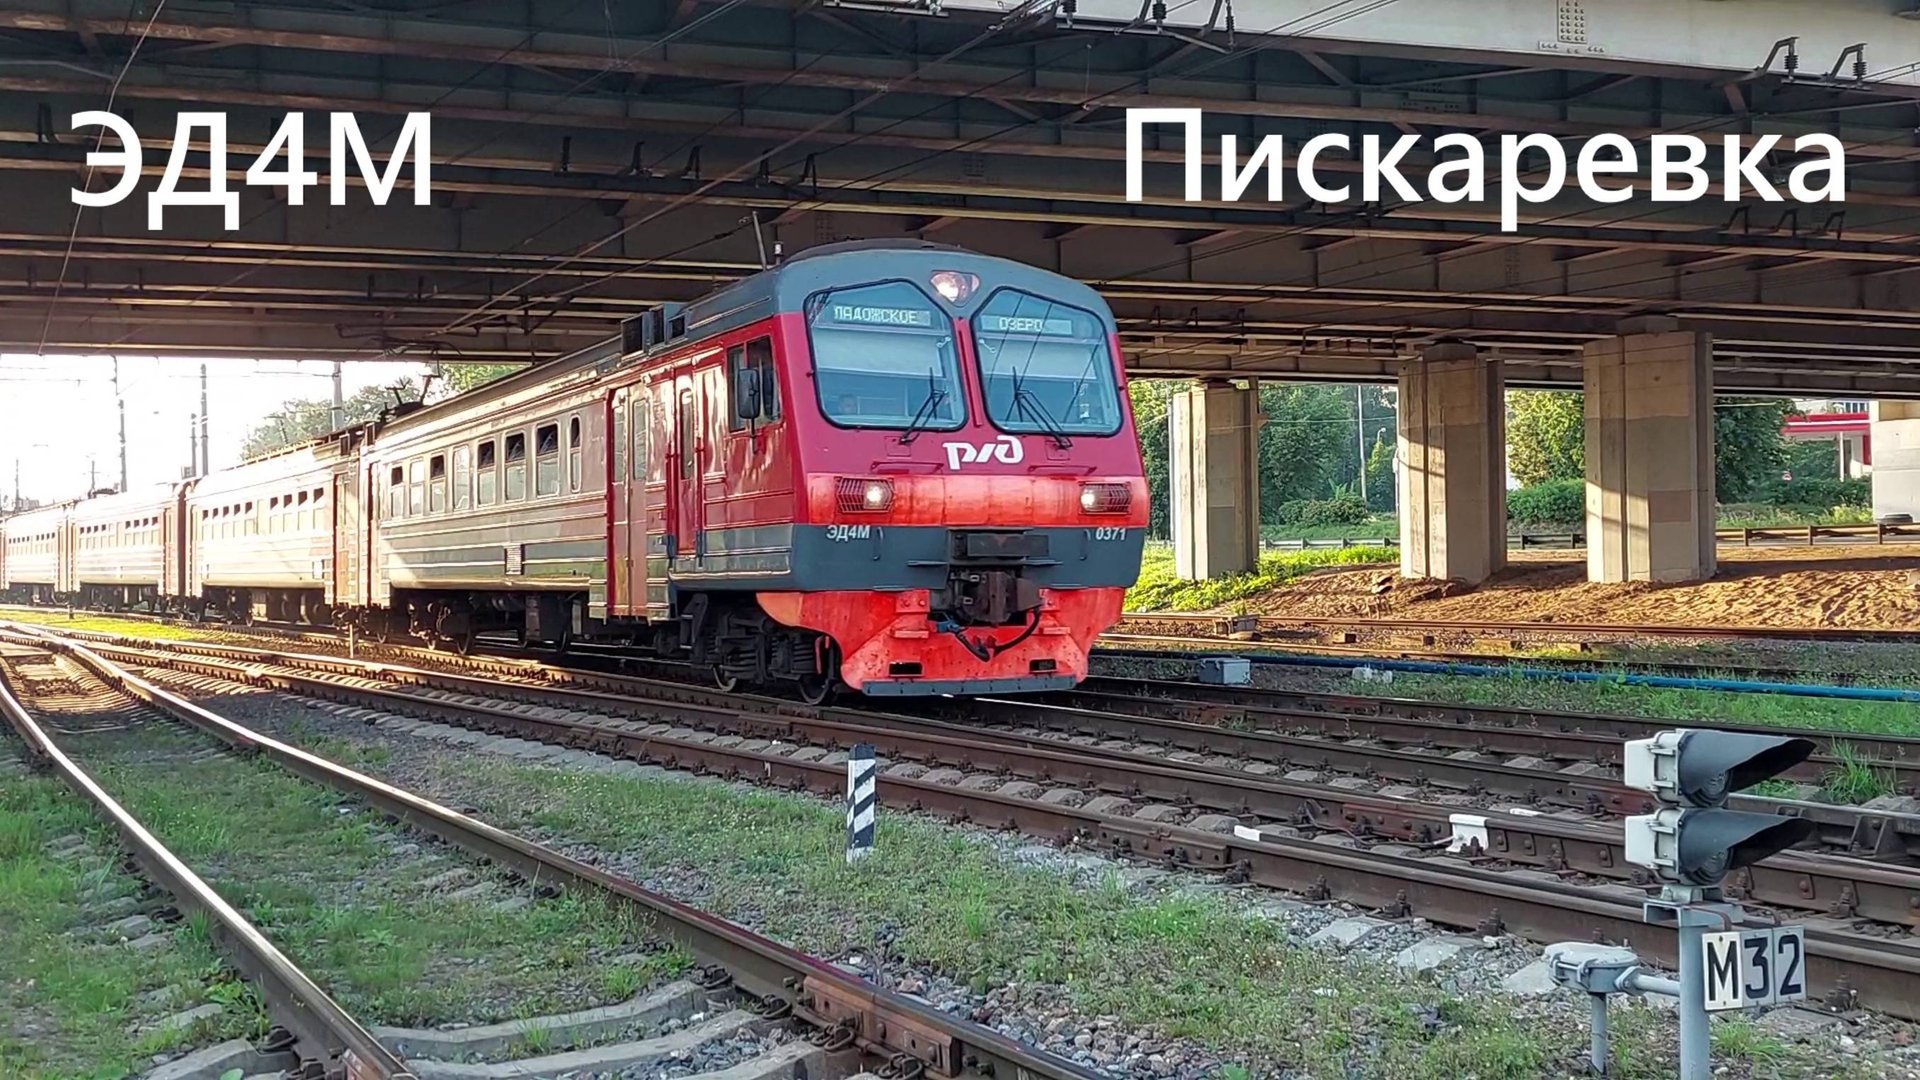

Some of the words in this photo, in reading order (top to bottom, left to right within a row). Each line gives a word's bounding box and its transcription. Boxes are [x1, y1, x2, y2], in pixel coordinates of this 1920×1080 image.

[999, 317, 1043, 332] ОЗЕРО
[826, 524, 870, 540] ЭД4М
[1095, 526, 1127, 541] 0371
